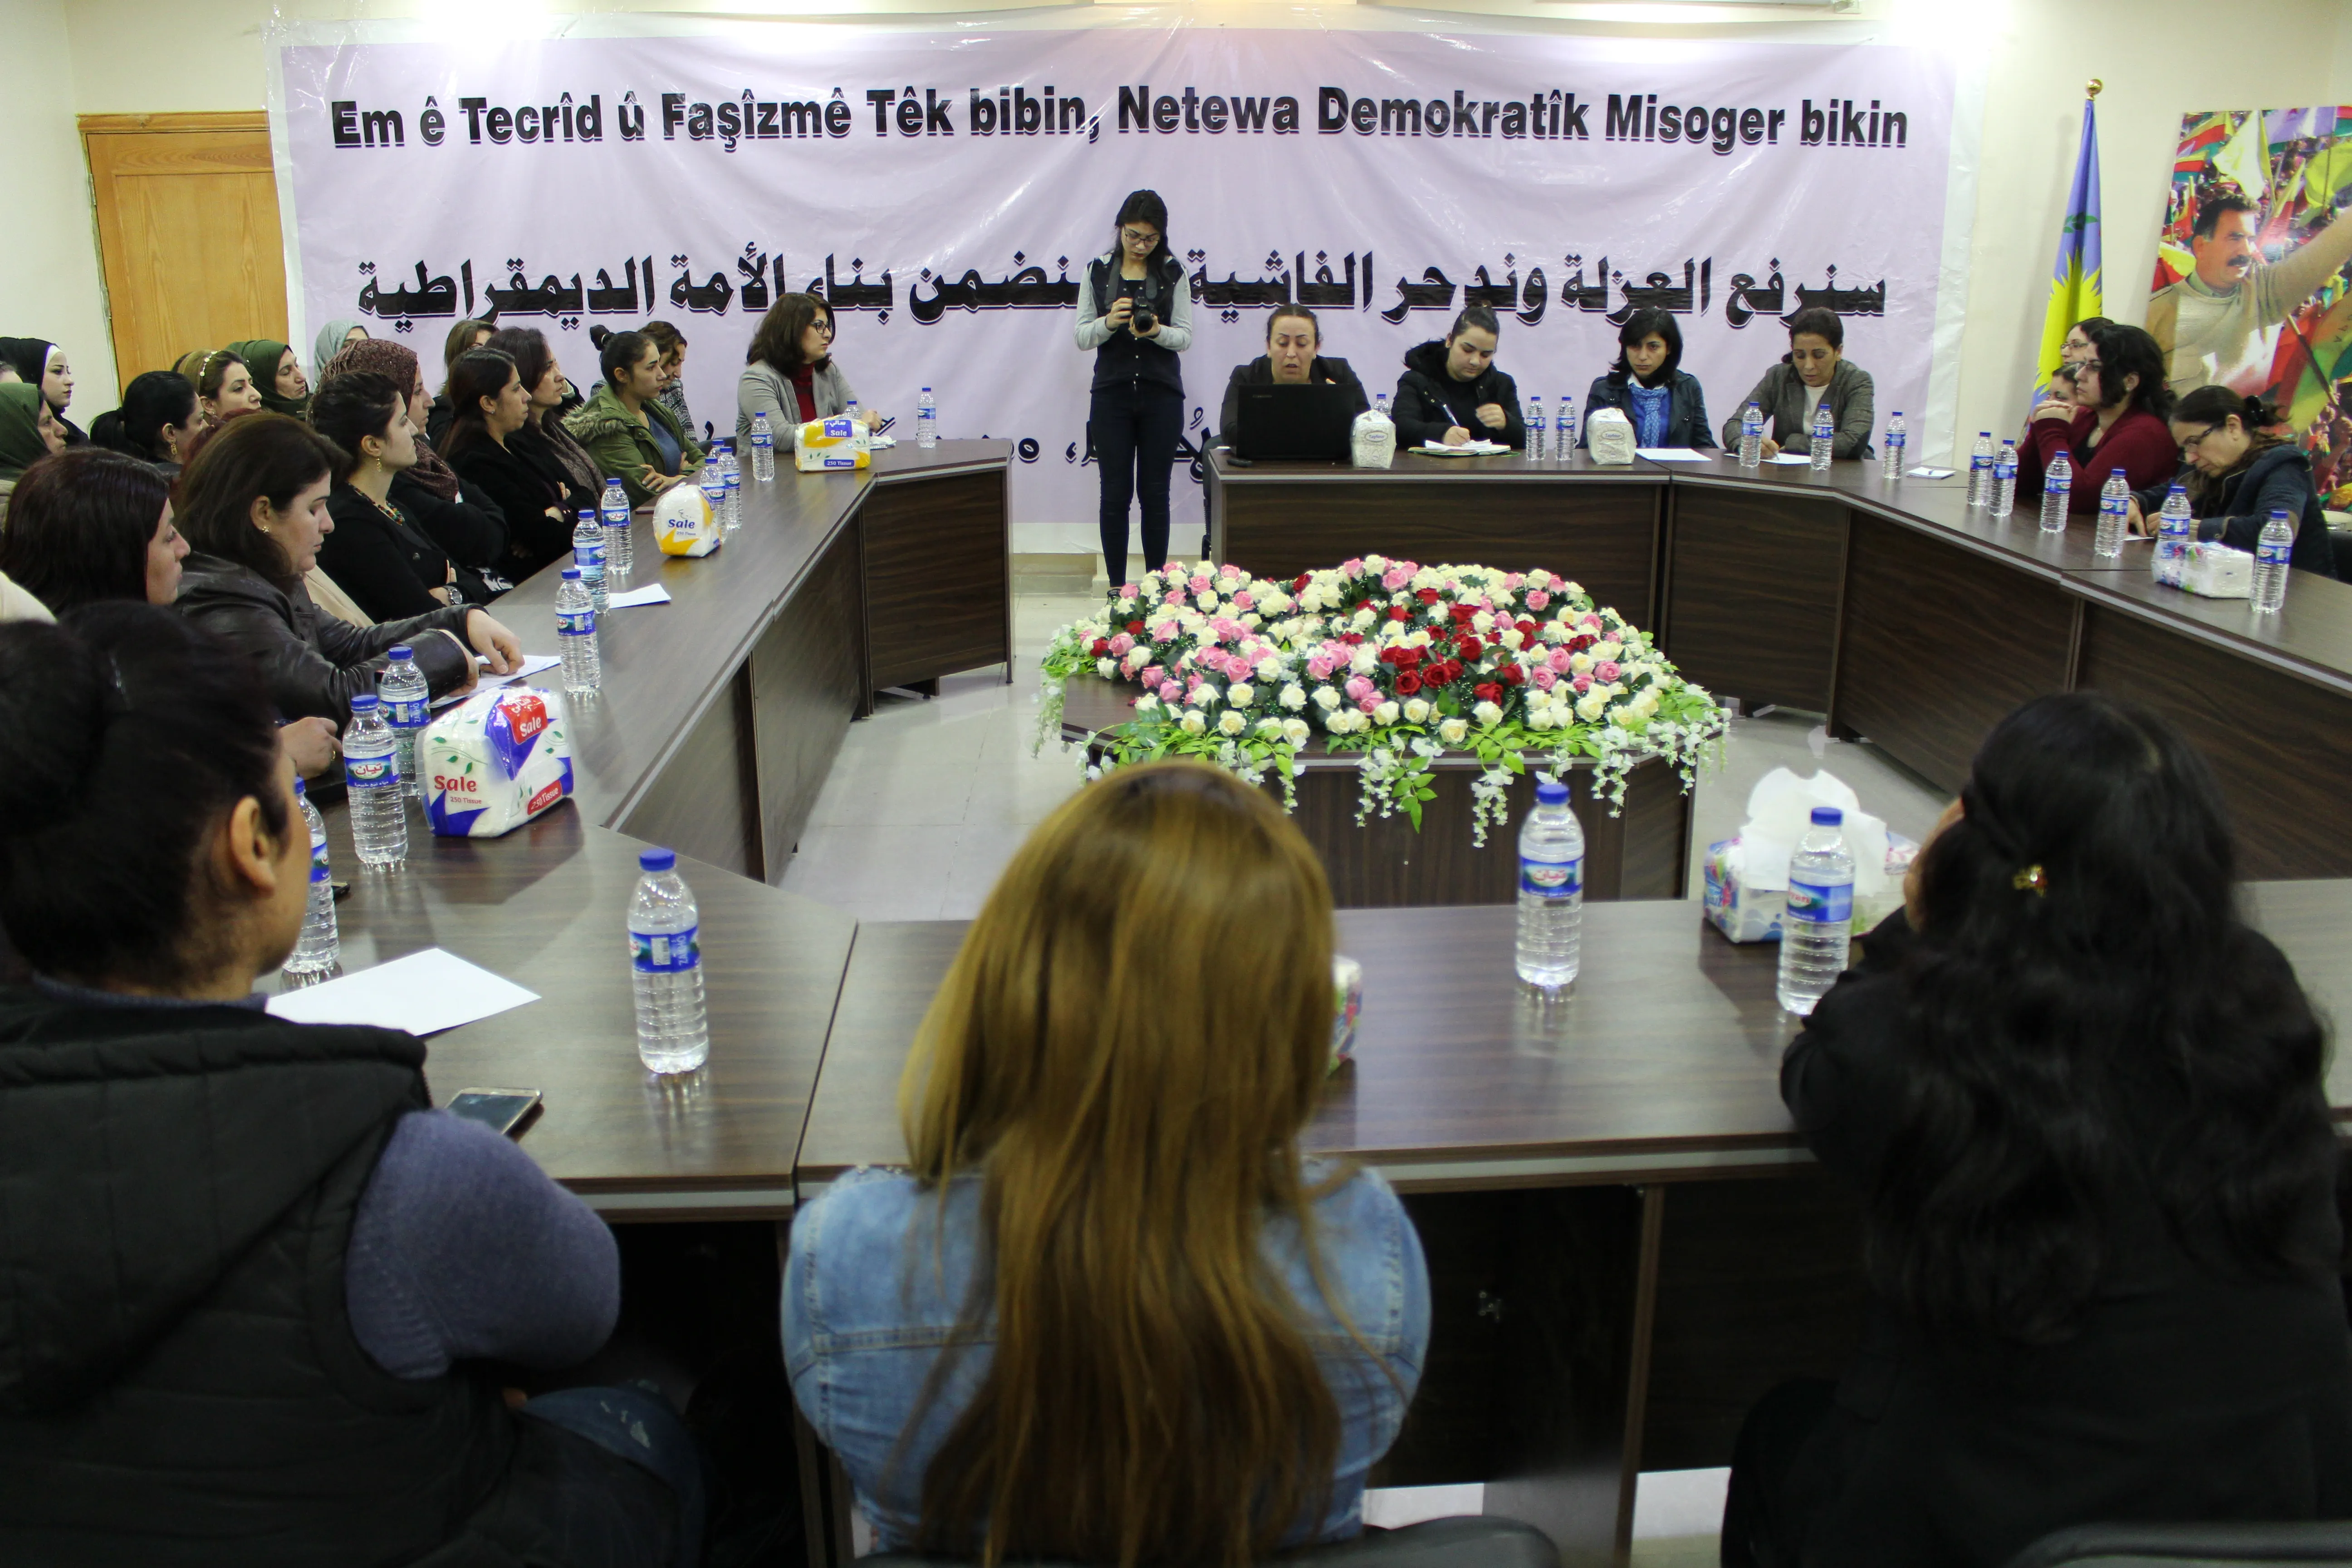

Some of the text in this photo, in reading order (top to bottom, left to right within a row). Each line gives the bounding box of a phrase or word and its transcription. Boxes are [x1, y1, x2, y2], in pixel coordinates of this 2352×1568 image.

[332, 86, 1907, 155] Em ê Tecrîd û Faşîzmê Têk bibin, Netewa Demokratîk Misoger bikin
[358, 241, 1886, 330] سنرفع العزلة وندحر الفاشية نضمن بناء الأمة الديمقراطية
[668, 519, 695, 529] Sale
[519, 717, 542, 737] Sale
[355, 763, 382, 775] تيان
[434, 775, 477, 792] Sale
[531, 788, 559, 810] 250 Tissue
